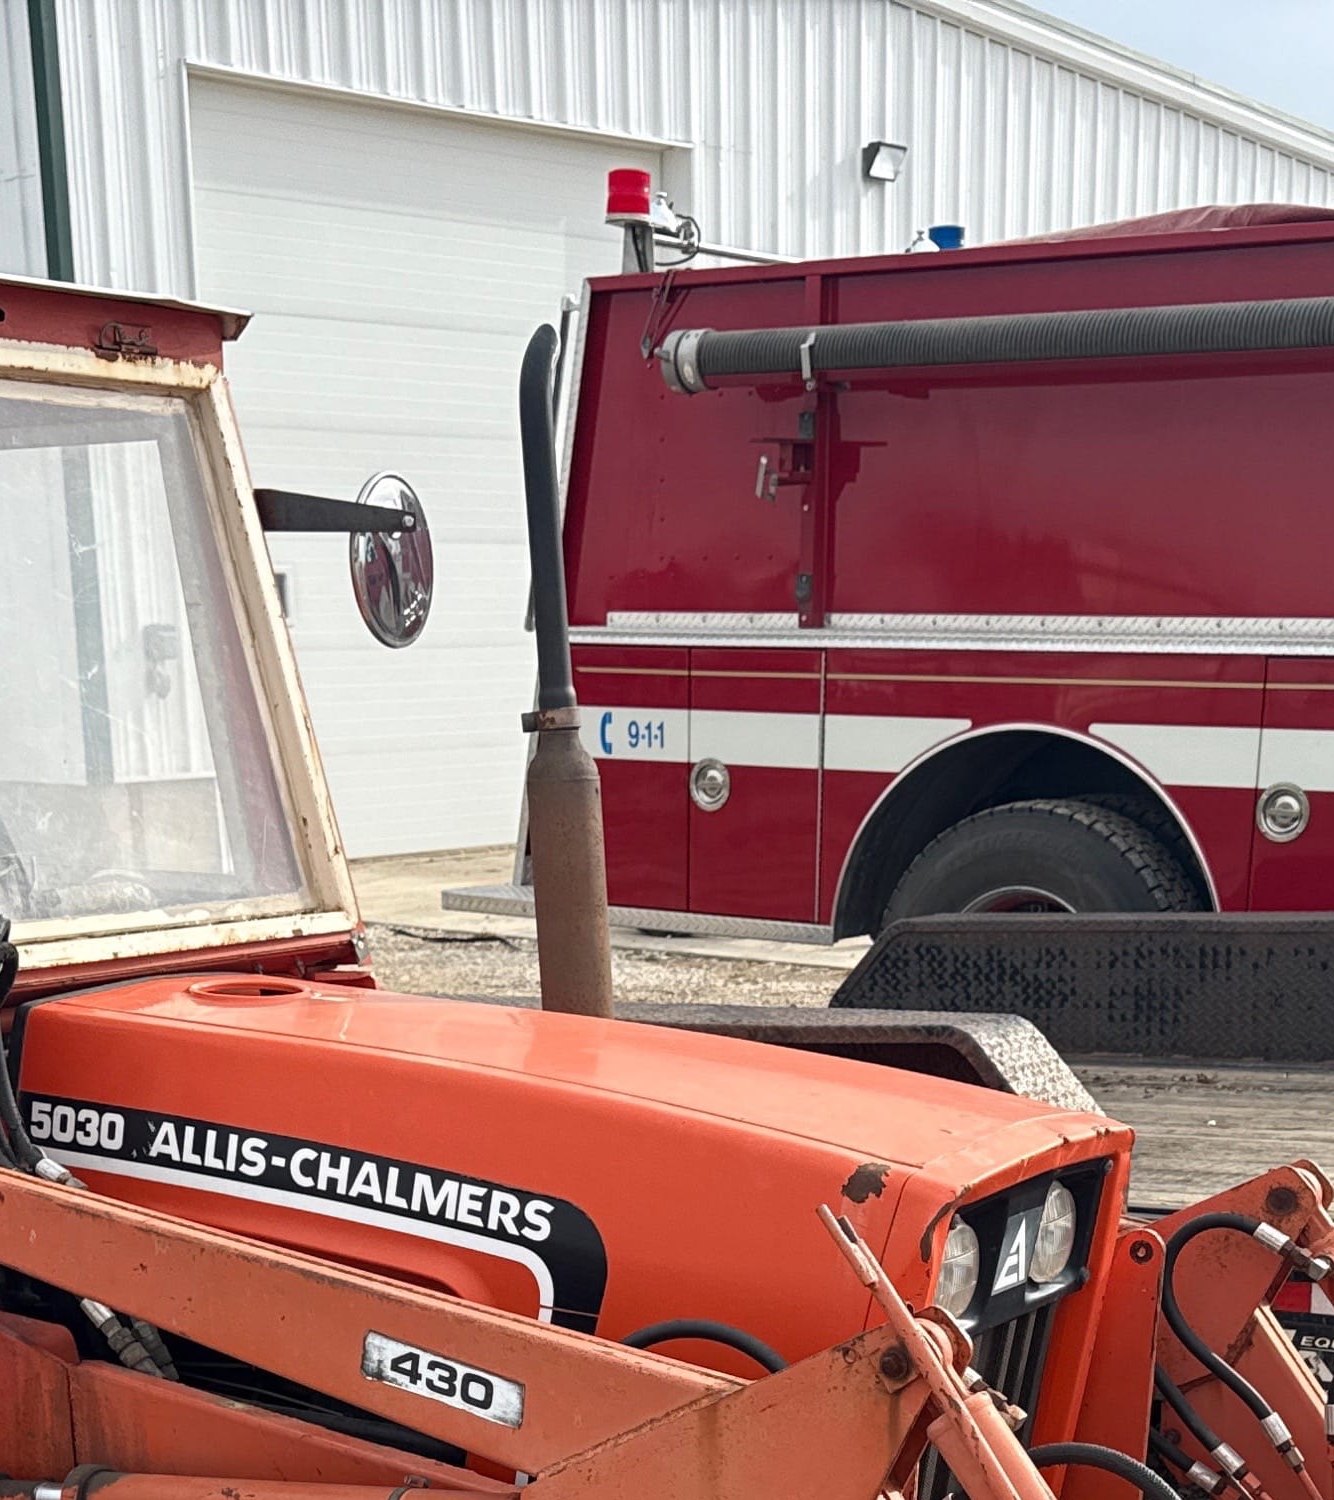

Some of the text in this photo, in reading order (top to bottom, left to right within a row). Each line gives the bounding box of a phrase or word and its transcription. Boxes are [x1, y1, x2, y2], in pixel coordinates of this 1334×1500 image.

[30, 1100, 125, 1150] 5030
[148, 1121, 556, 1242] ALLIS-CHALMERS
[390, 1351, 494, 1411] 430
